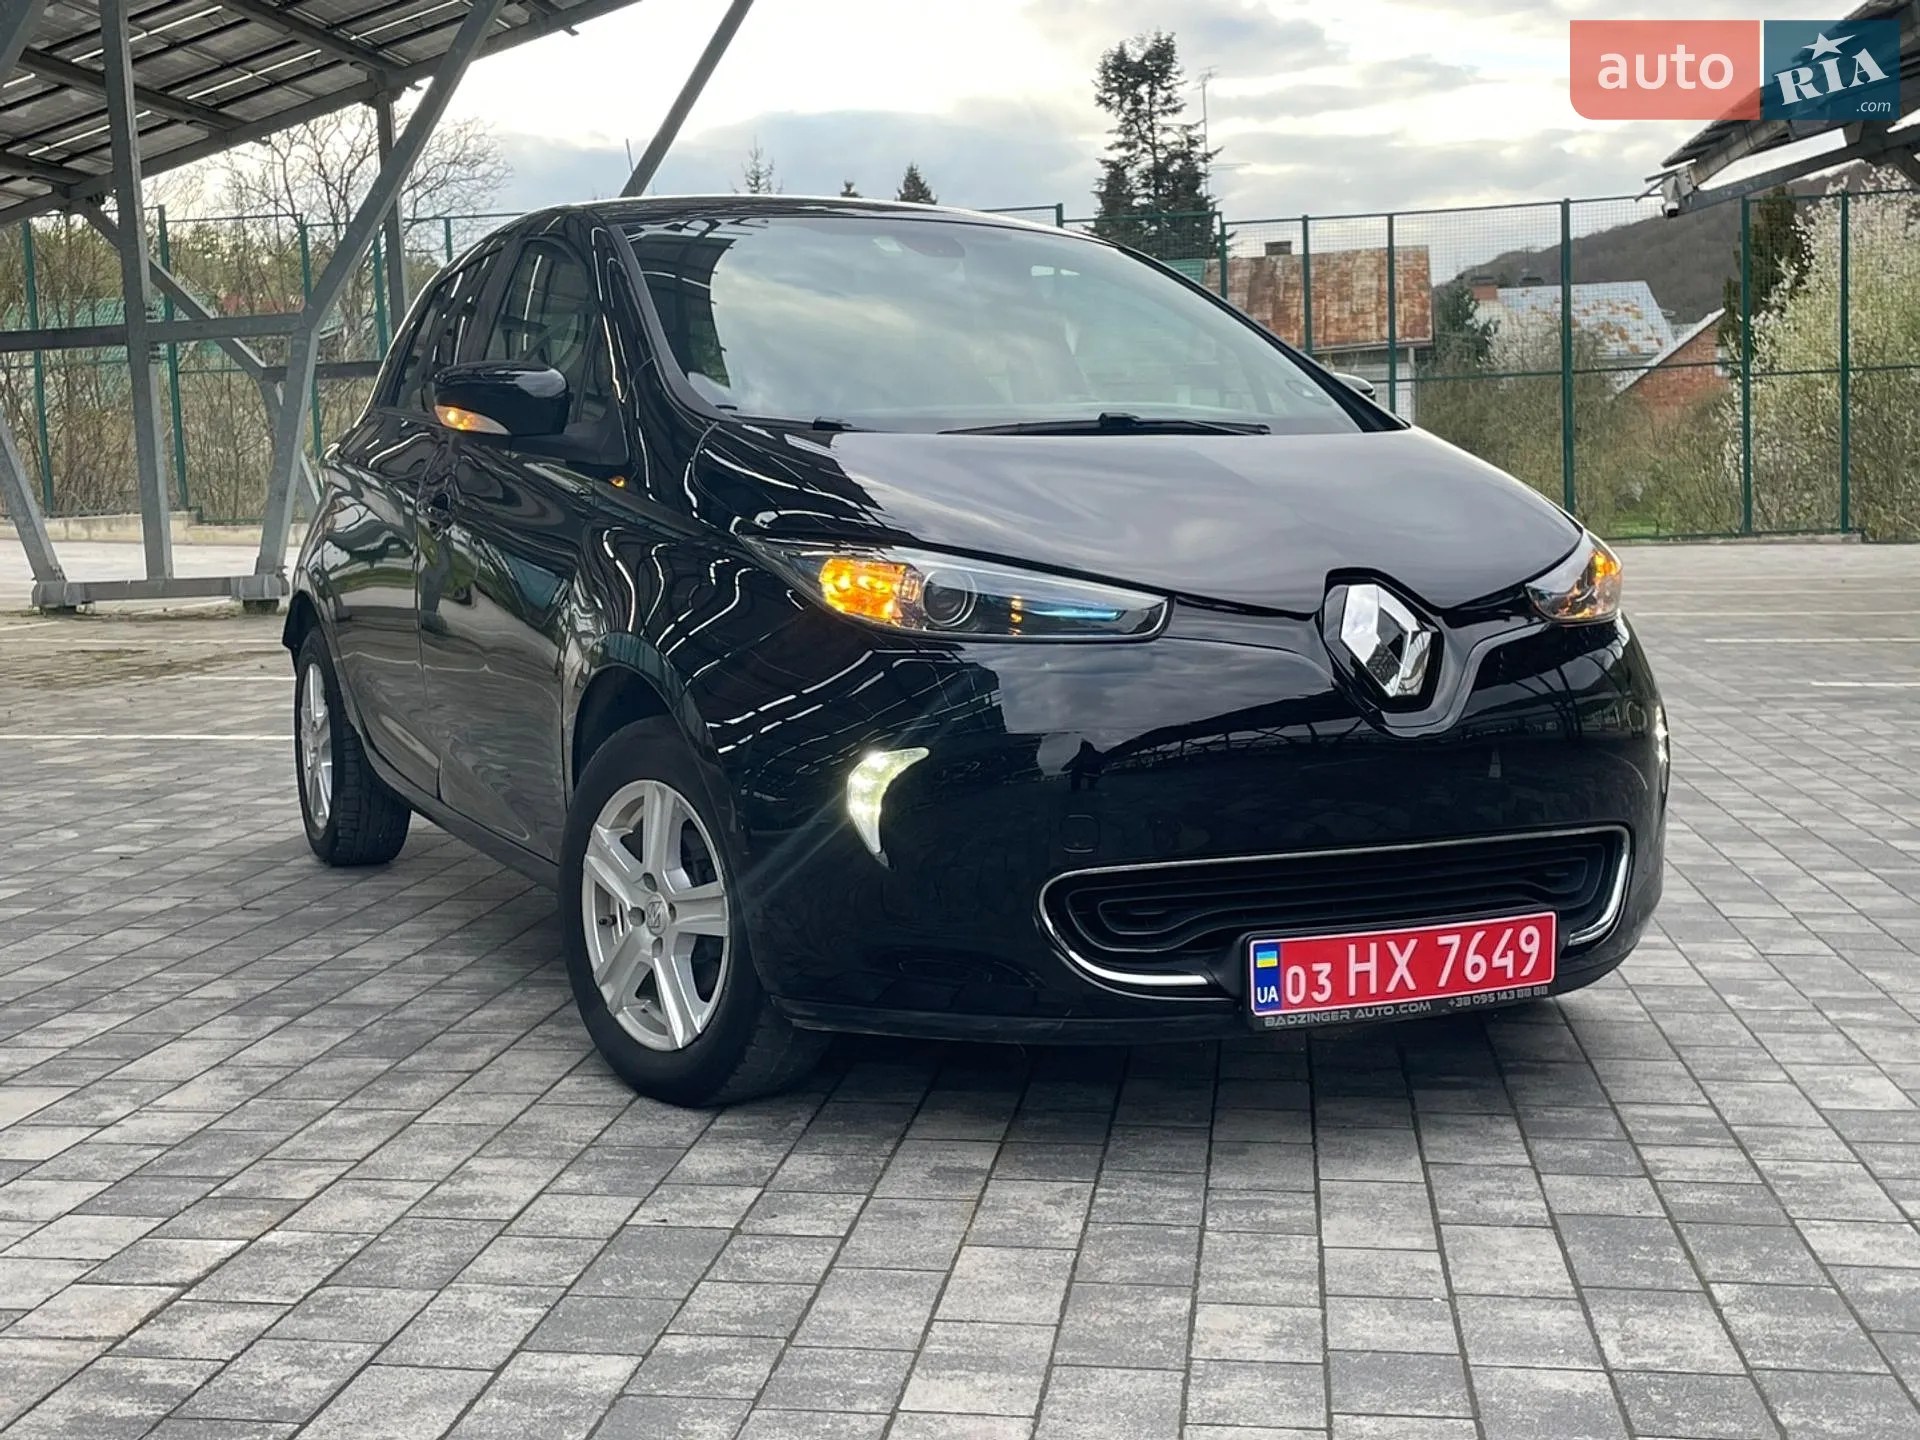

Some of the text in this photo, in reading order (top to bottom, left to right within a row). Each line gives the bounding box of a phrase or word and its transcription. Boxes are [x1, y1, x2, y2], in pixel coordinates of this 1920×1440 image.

[1285, 925, 1541, 1005] 03 HX 7649
[1256, 986, 1279, 1004] UA
[1264, 1010, 1350, 1028] BADZINGER
[1472, 992, 1496, 1005] 095
